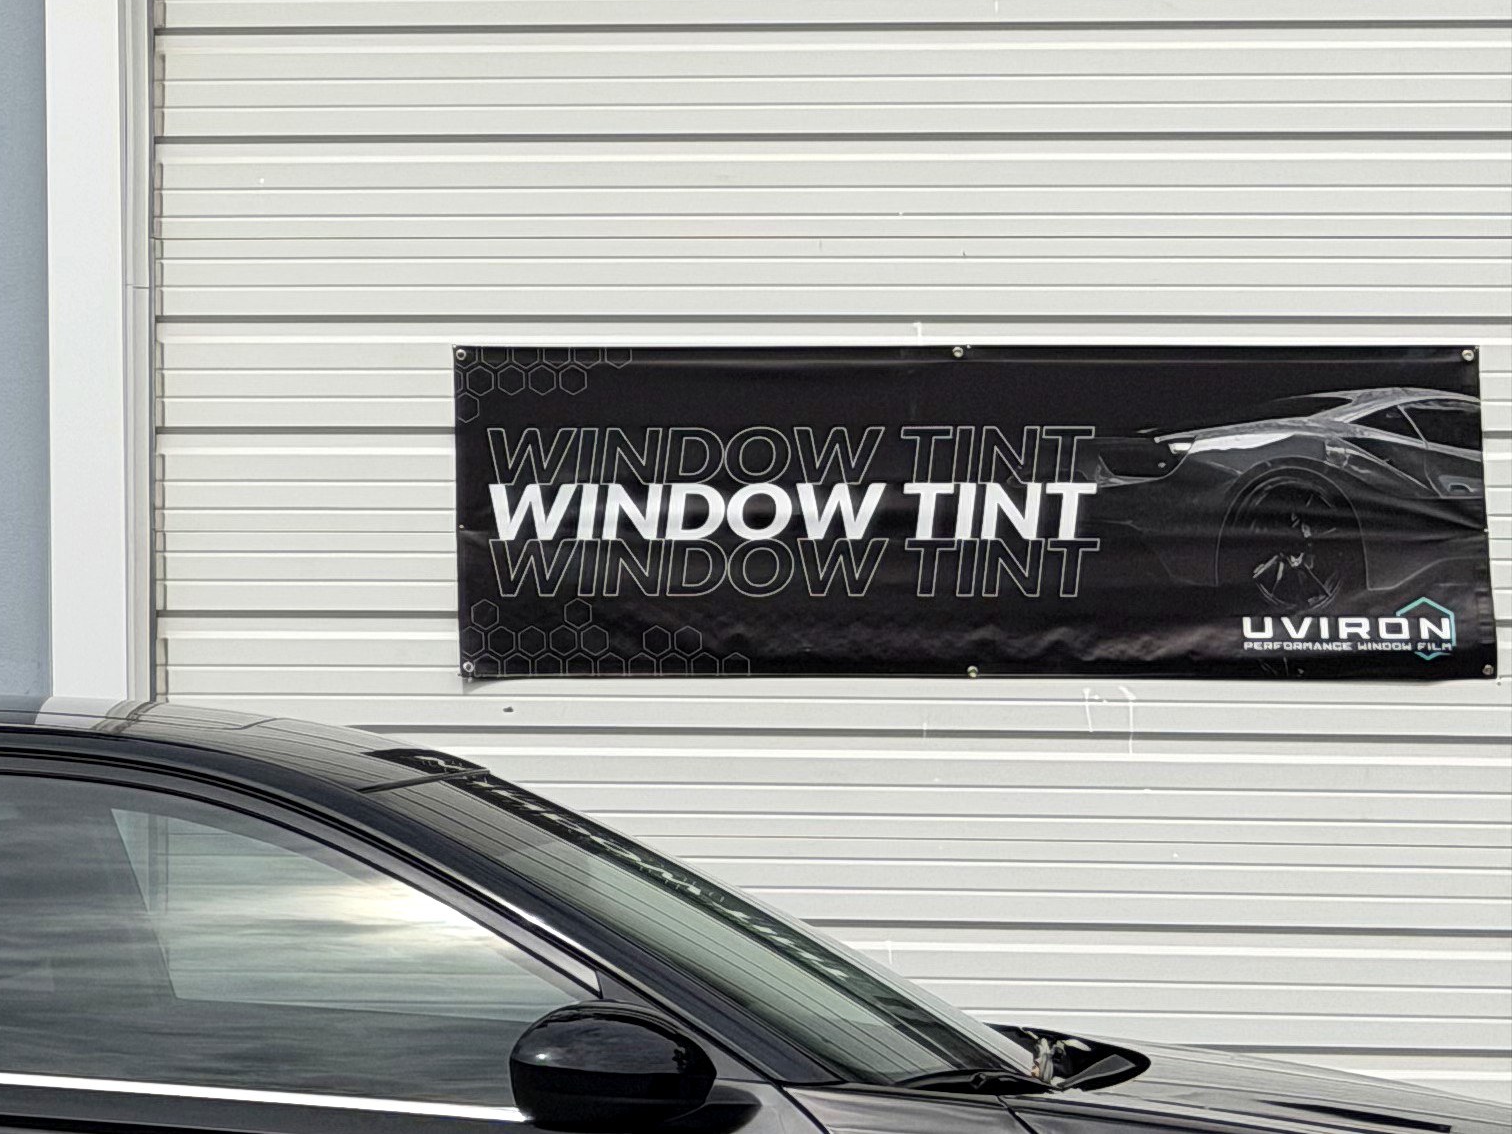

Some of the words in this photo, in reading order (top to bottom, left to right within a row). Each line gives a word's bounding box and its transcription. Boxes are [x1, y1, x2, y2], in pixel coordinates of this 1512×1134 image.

[487, 426, 885, 485] WINDOW
[901, 426, 1095, 485] TINT
[489, 482, 887, 541] WINDOW
[903, 482, 1098, 540] TINT
[489, 538, 889, 597] WINDOW
[905, 538, 1100, 597] TINT
[1242, 617, 1451, 639] UVIRON
[1243, 641, 1353, 651] PERFORMANCE
[1357, 641, 1412, 651] WINDOW
[1417, 642, 1453, 651] FILM
